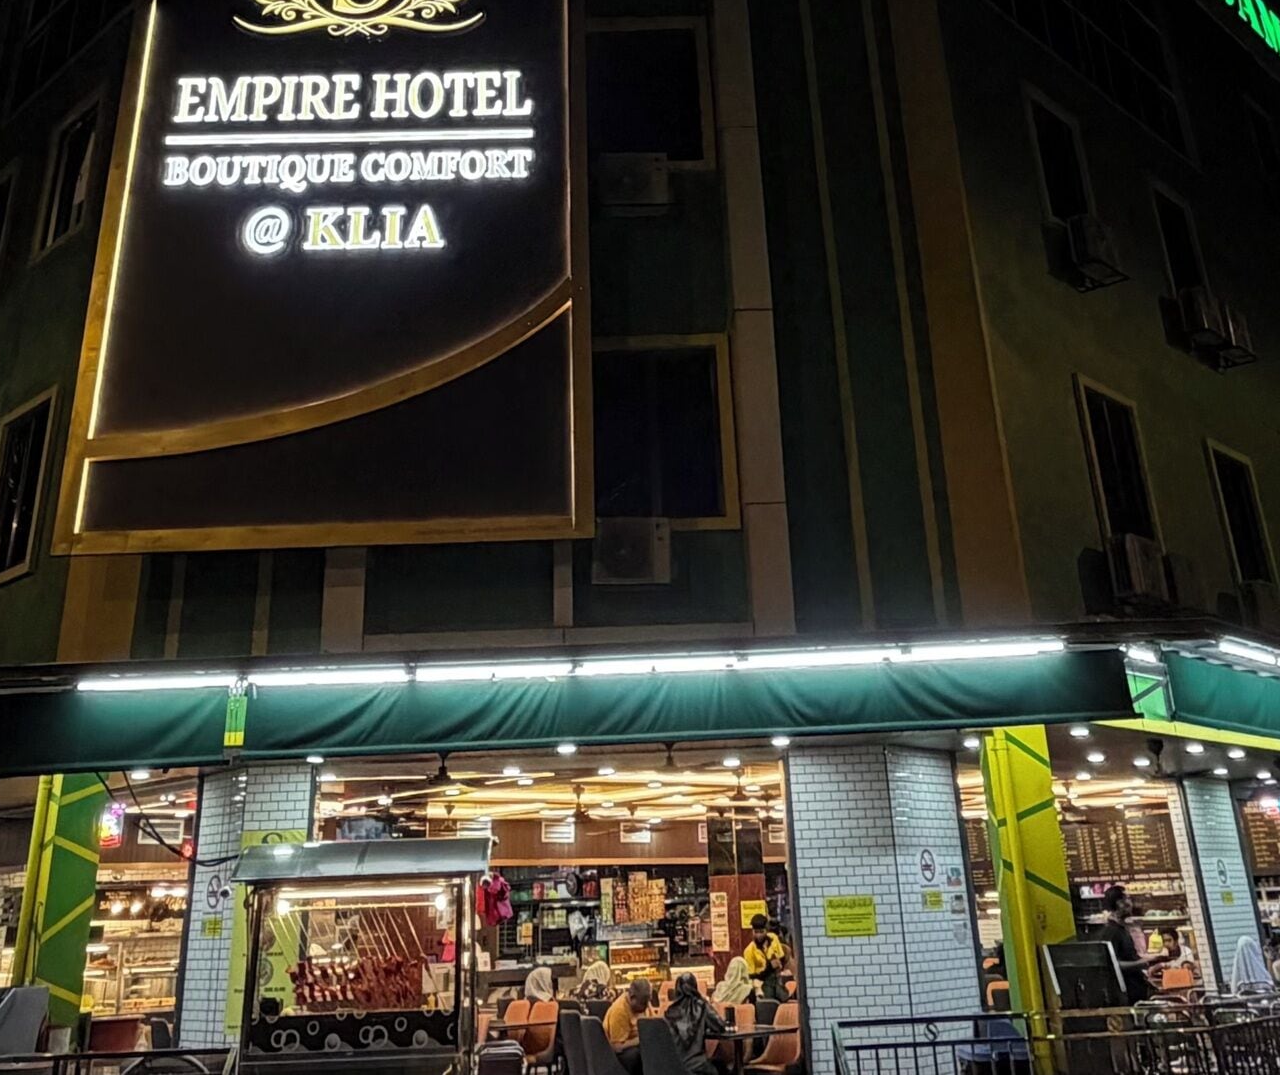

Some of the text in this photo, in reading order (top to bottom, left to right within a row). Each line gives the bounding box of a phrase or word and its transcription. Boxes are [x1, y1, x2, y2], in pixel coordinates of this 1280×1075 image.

[173, 70, 533, 124] EMPIRE HOTEL
[164, 149, 534, 192] BOUTIQUE COMFORT
[244, 204, 445, 255] @ KLIA
